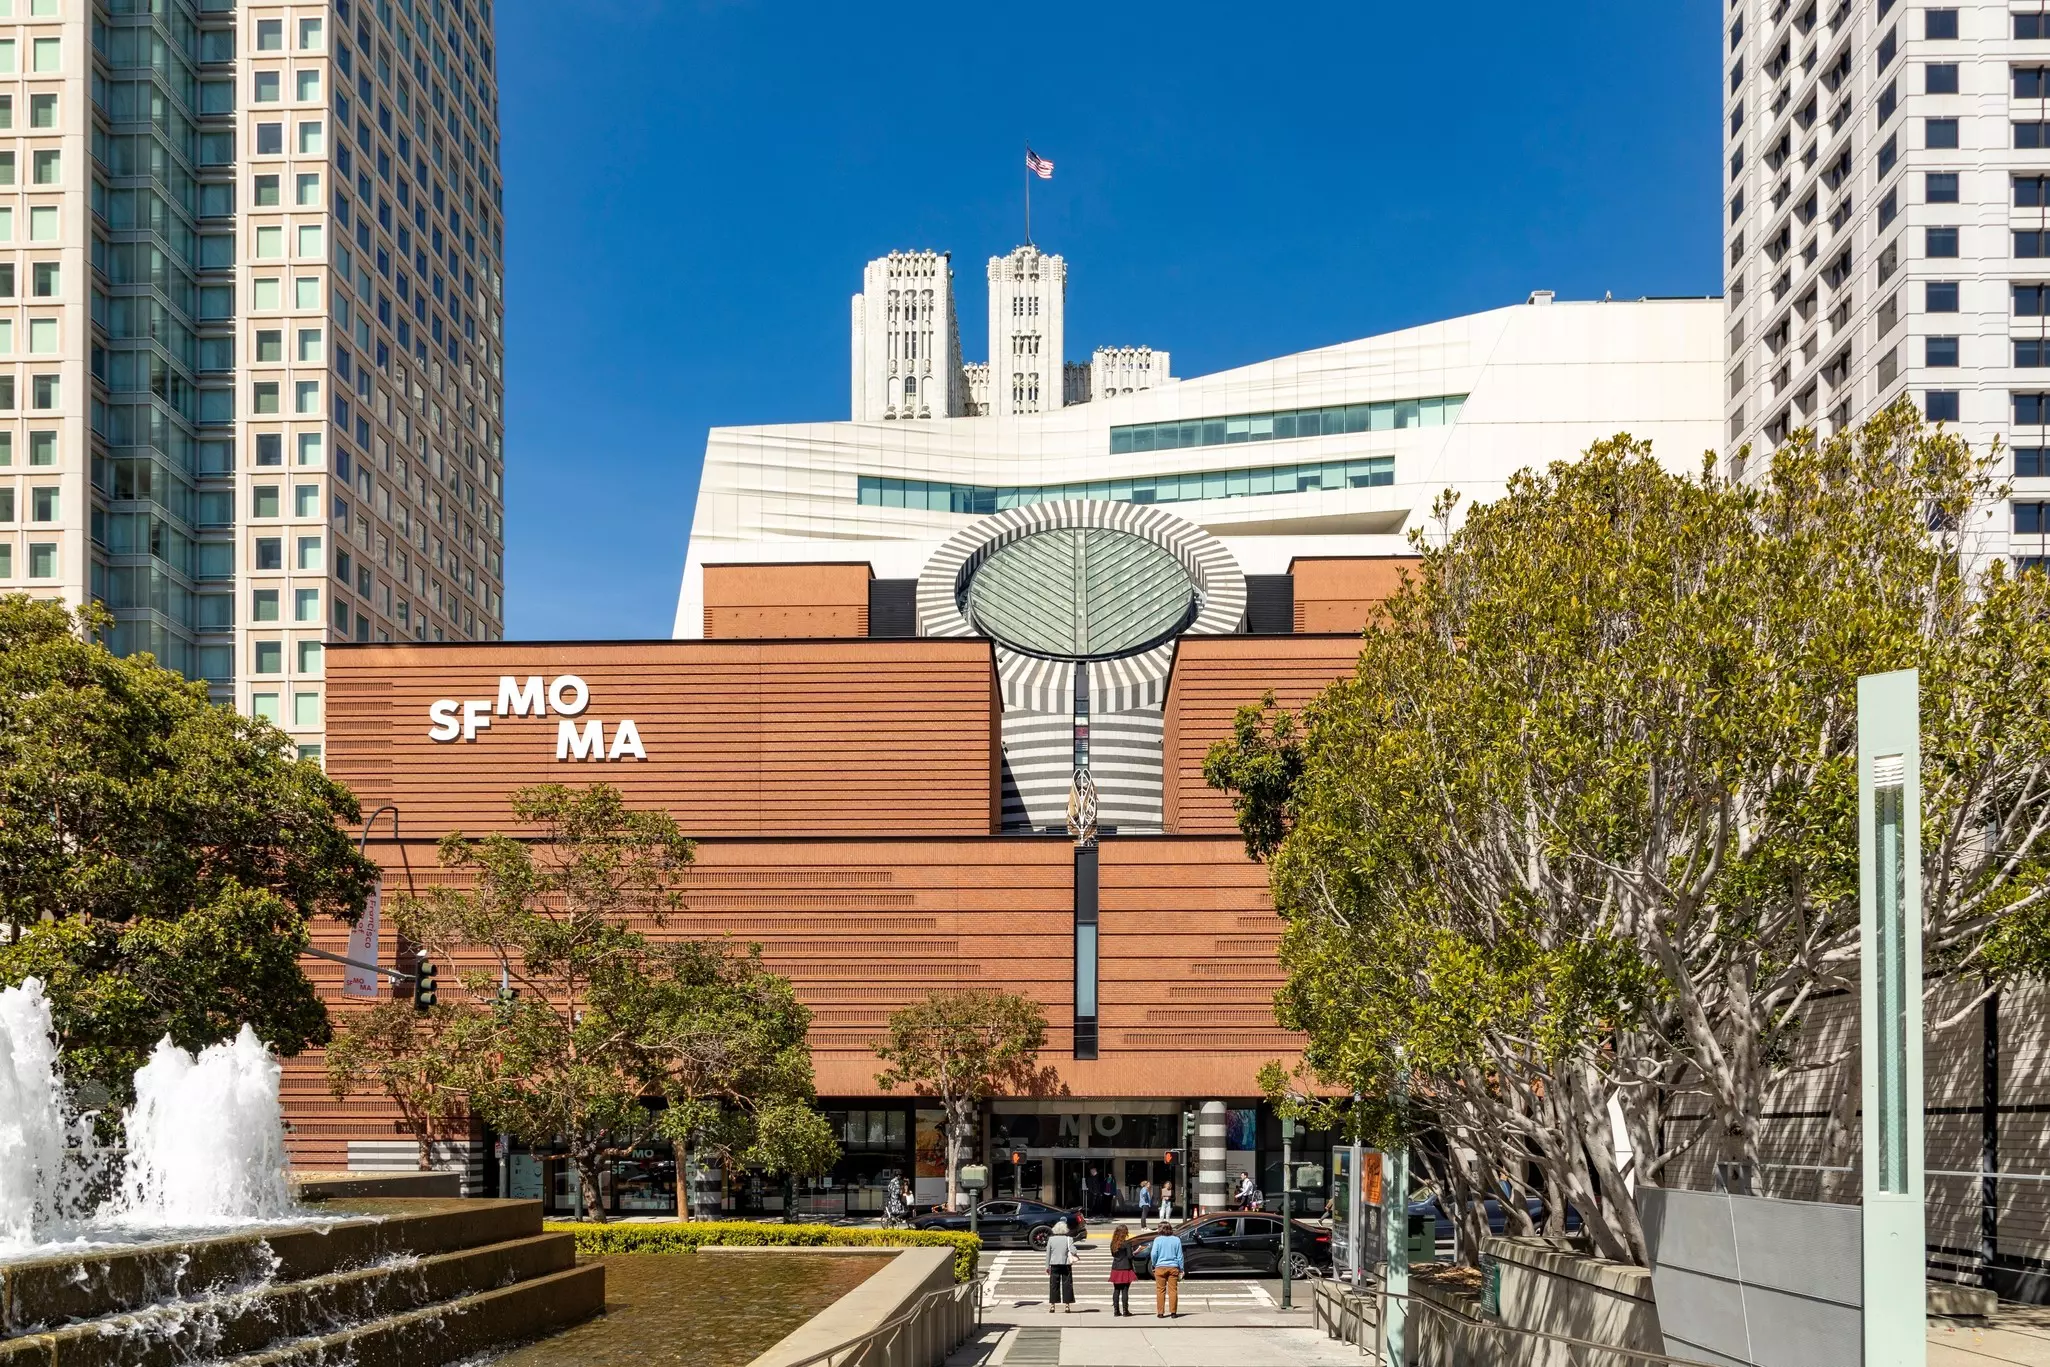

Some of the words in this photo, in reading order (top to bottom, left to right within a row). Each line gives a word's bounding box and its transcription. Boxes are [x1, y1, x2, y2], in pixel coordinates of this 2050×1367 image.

[497, 675, 590, 716] MO
[428, 699, 492, 741] SF
[556, 719, 648, 759] MA
[357, 922, 366, 935] of
[364, 900, 377, 949] Francisco
[1059, 1114, 1123, 1137] MO
[611, 1164, 626, 1175] SF
[632, 1149, 655, 1159] MO
